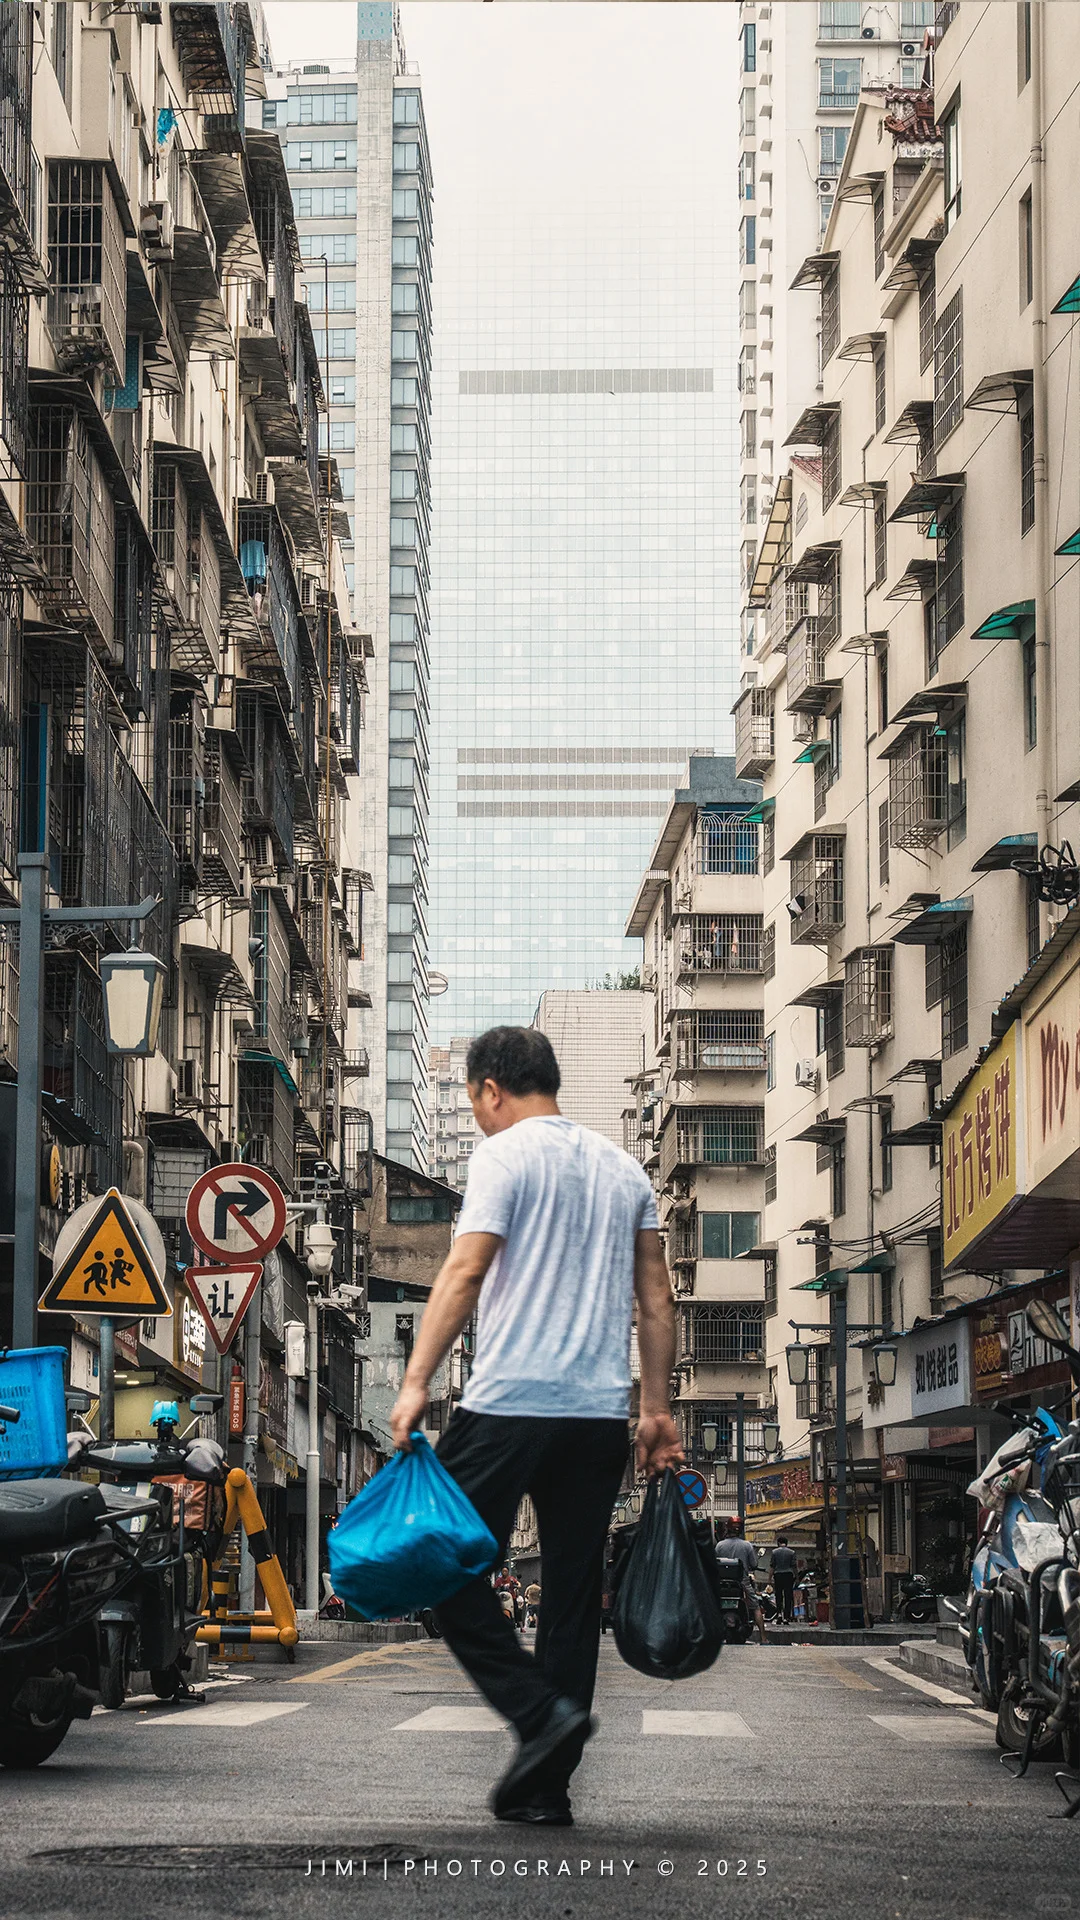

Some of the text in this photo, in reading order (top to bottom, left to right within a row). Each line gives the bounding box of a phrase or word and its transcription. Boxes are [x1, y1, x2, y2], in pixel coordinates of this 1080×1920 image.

[945, 1056, 1012, 1241] 北方烤饼
[208, 1280, 234, 1319] 让
